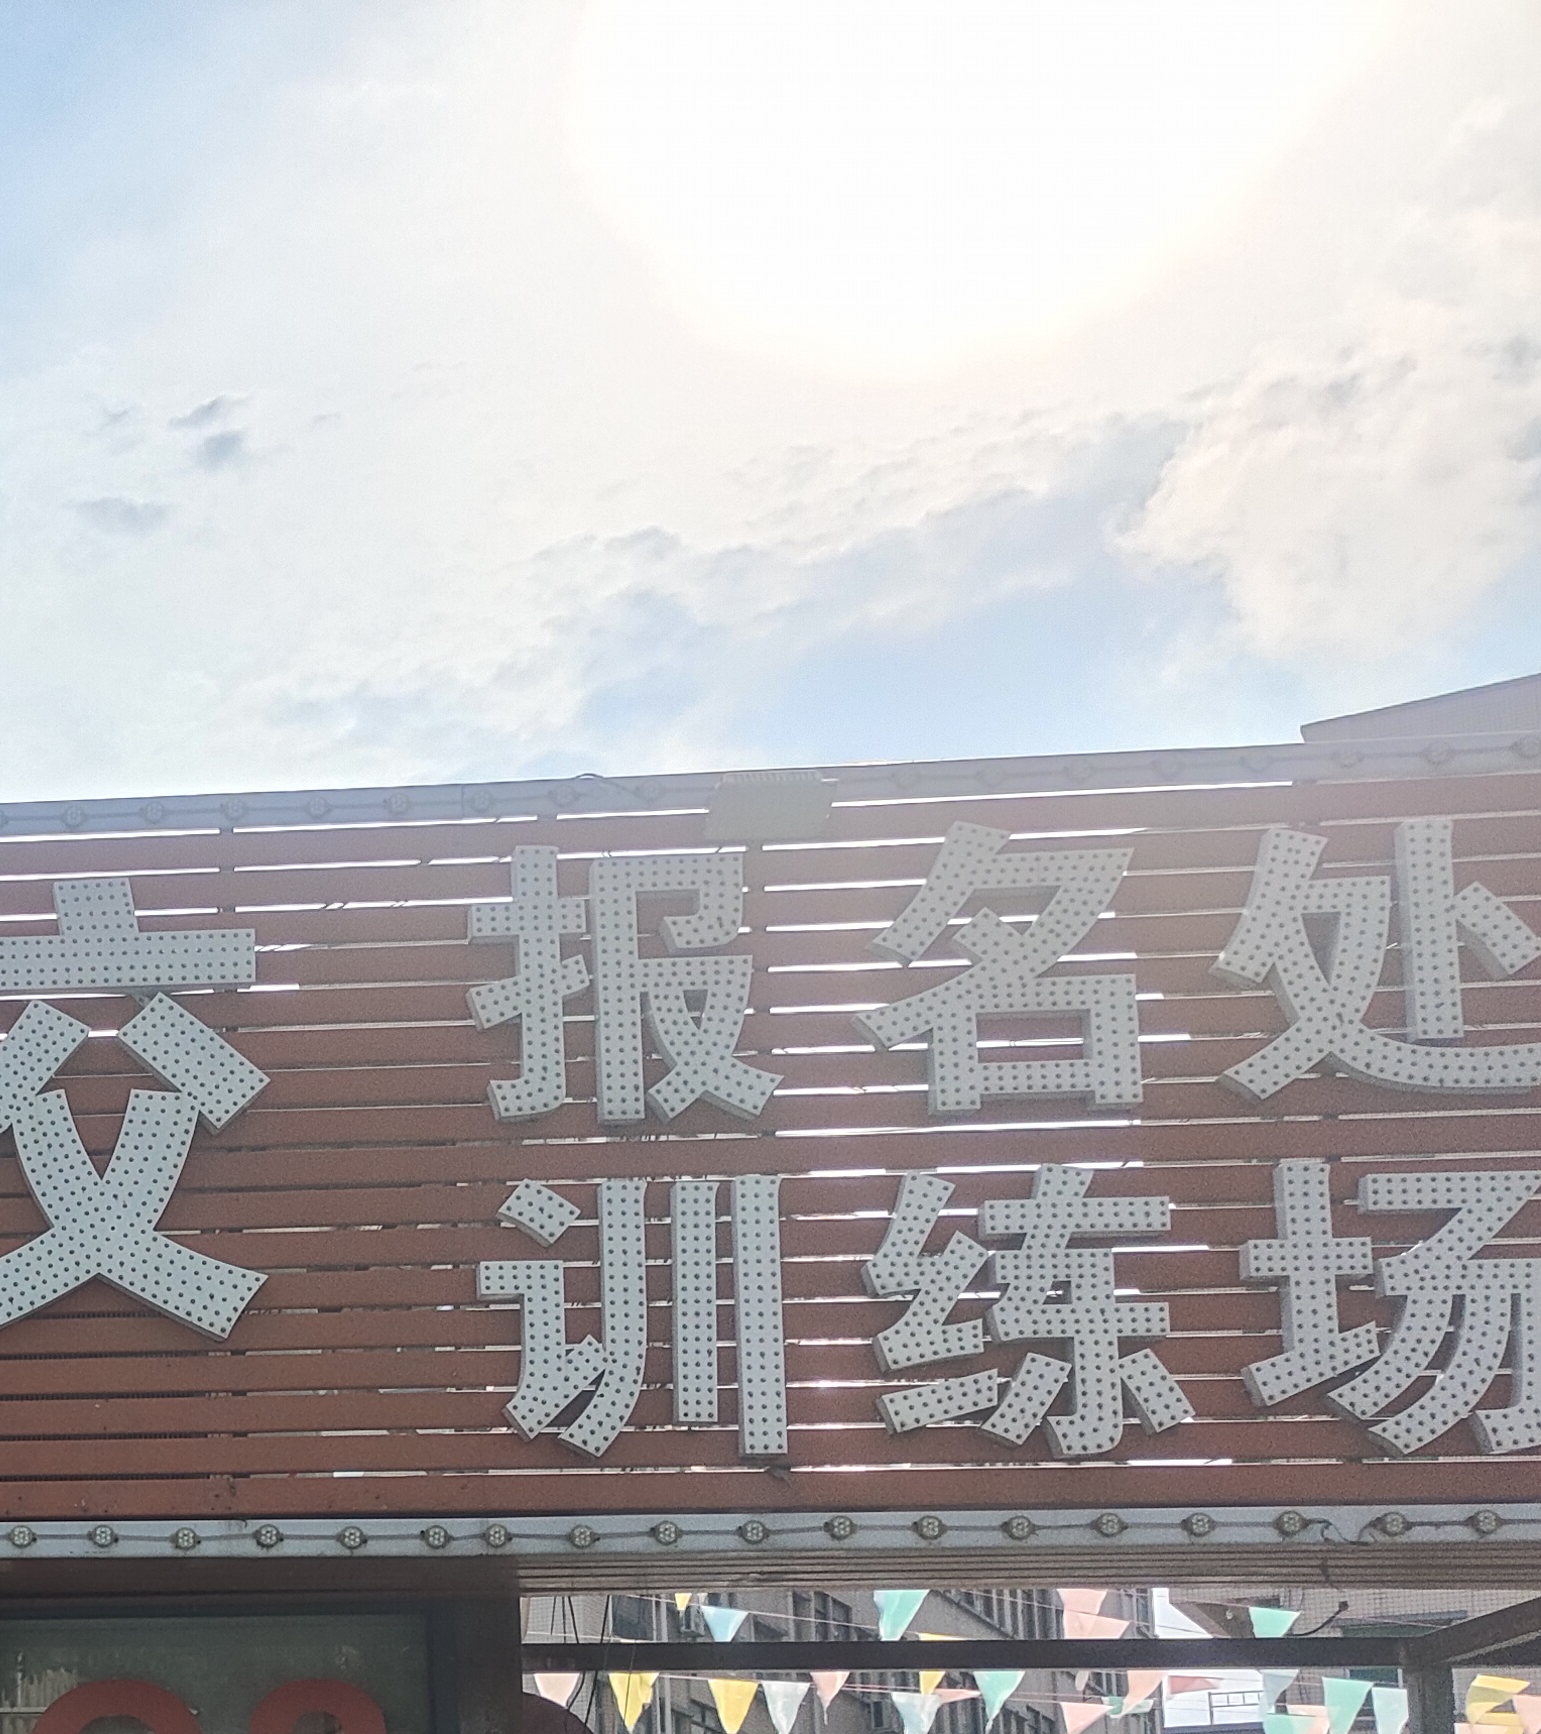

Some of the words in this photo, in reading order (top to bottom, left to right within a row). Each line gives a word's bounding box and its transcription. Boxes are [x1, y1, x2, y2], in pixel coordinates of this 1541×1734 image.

[466, 819, 1541, 1124] 报名处
[477, 1160, 1541, 1458] 训练场
